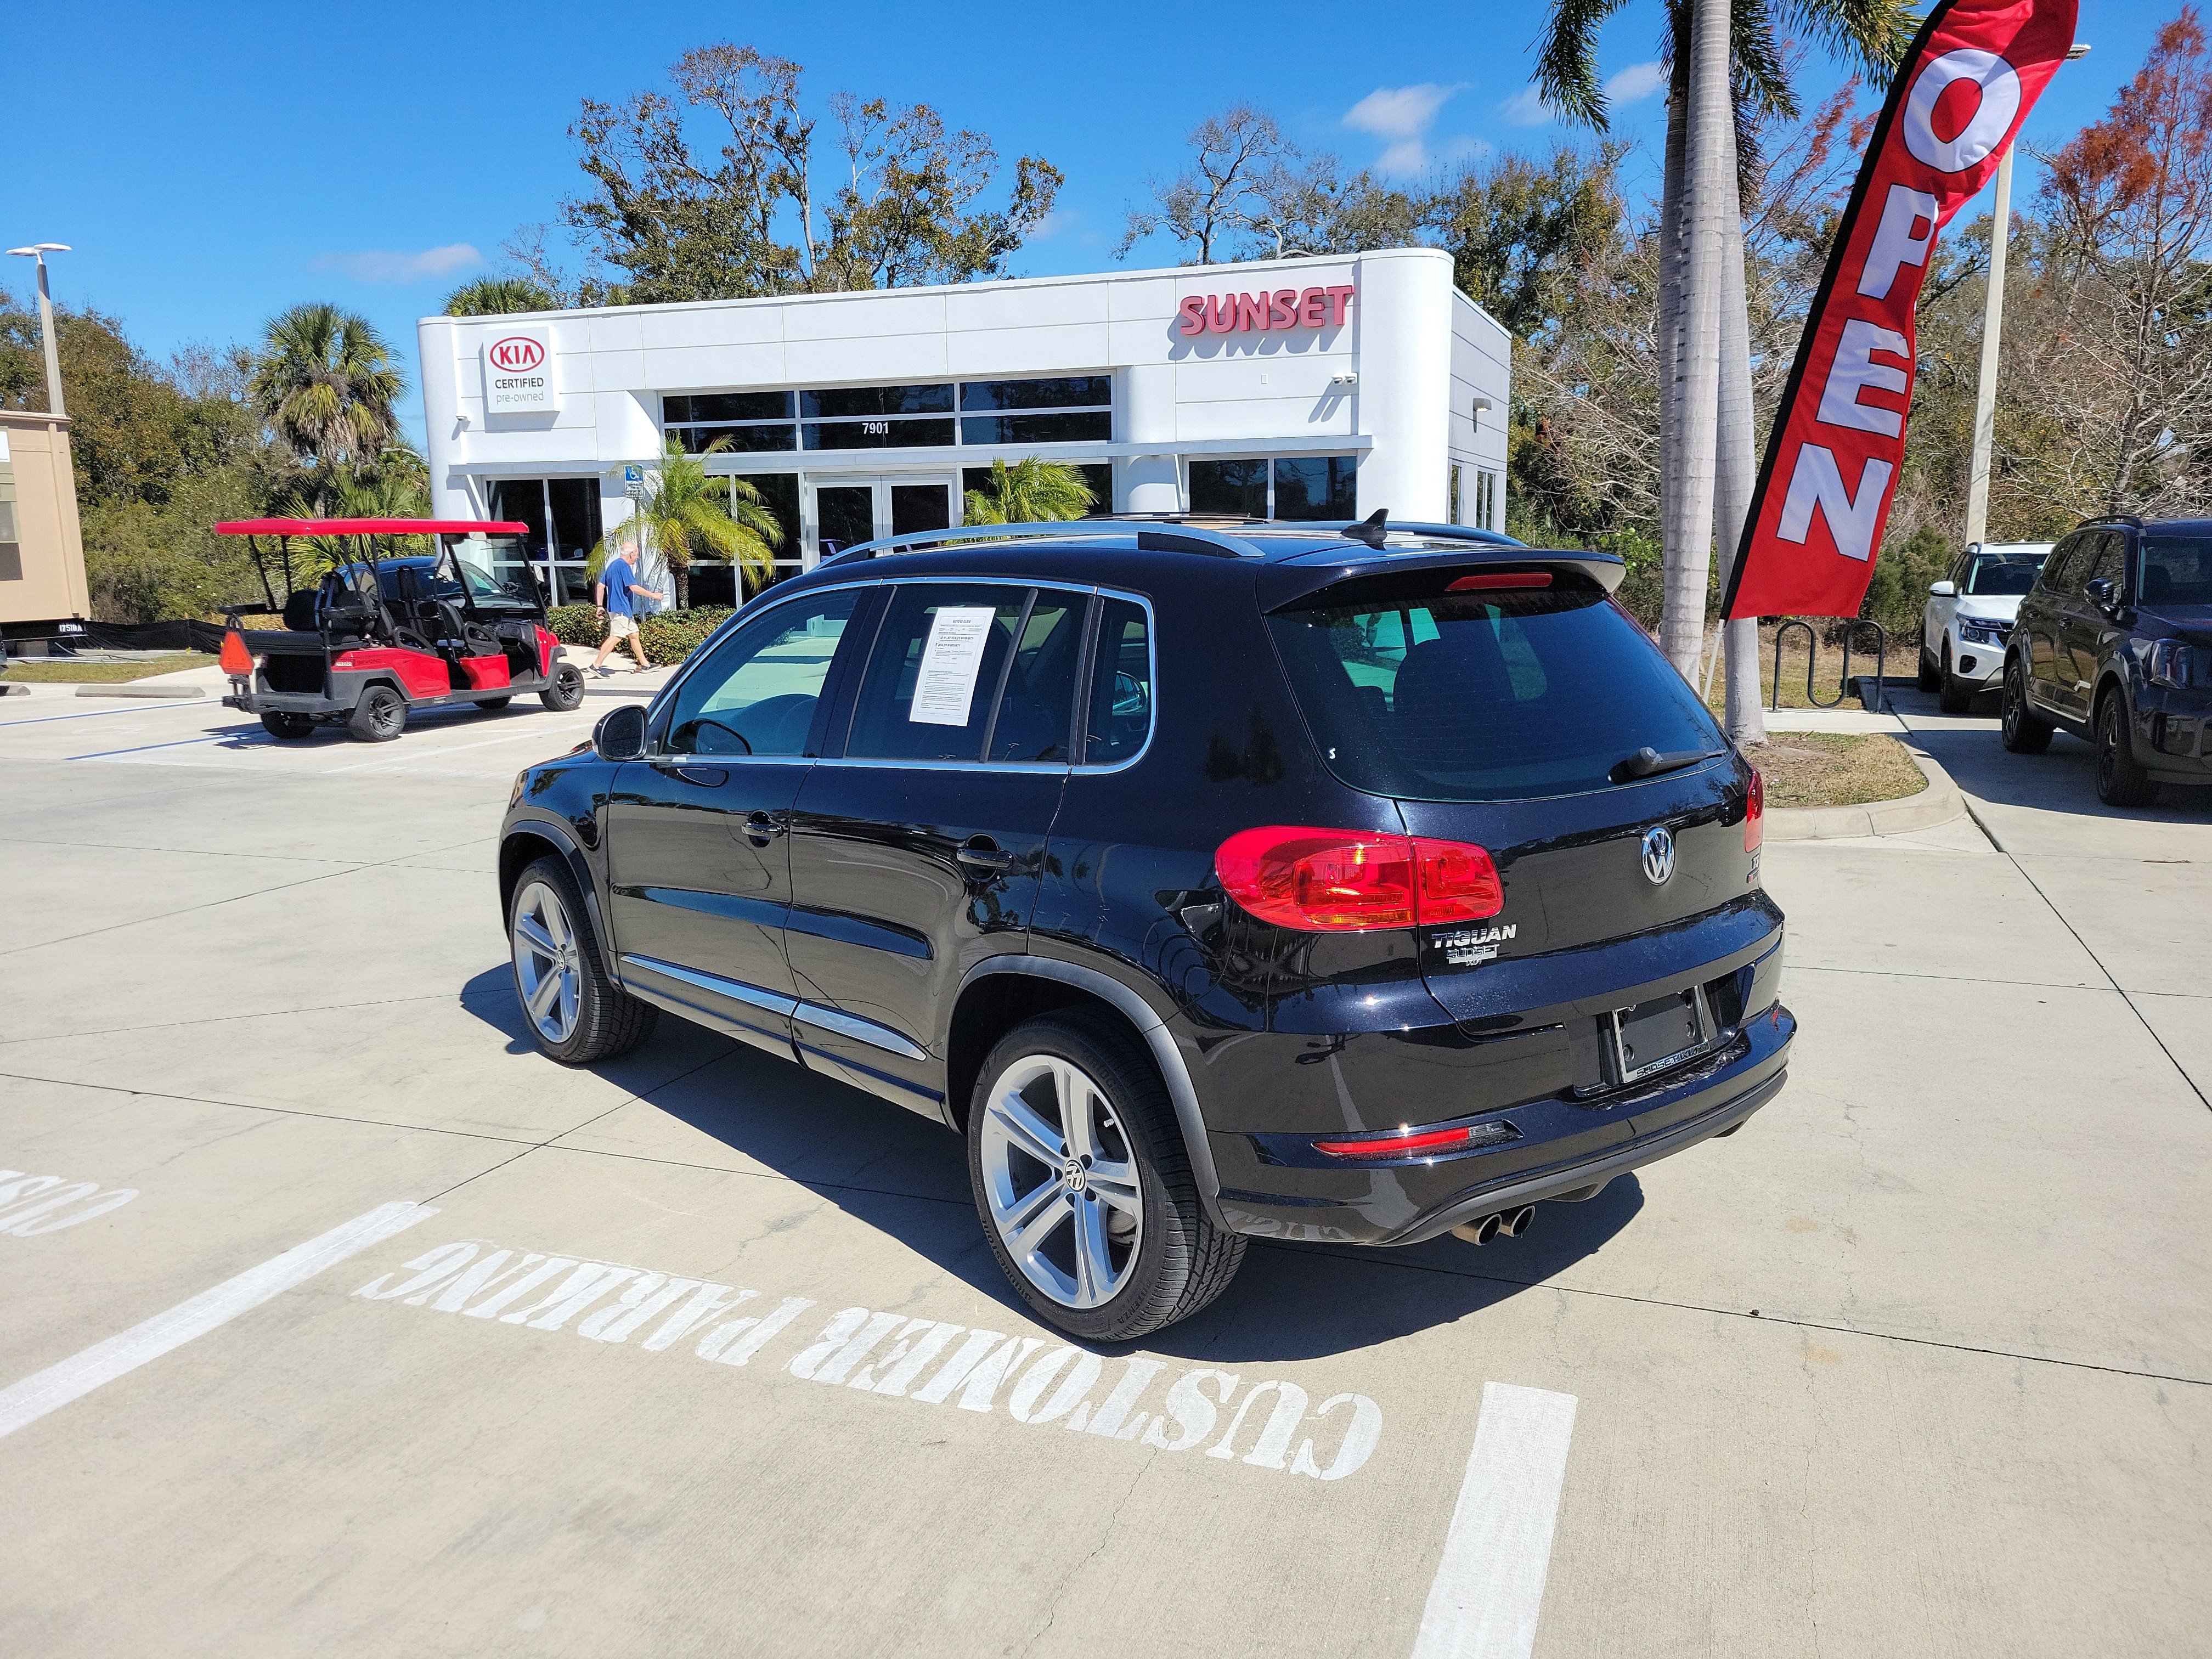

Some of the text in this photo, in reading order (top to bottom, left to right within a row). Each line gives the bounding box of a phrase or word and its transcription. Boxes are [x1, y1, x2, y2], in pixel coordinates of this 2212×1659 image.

[1180, 285, 1355, 336] SUNSET
[1776, 48, 2022, 561] OPEN
[499, 345, 537, 365] KIA
[495, 377, 544, 389] CERTIFIED
[496, 391, 544, 405] pre-owned
[862, 421, 889, 434] 7901
[1431, 924, 1516, 948] TIGUAN
[1446, 944, 1500, 960] SUNSET
[1637, 1056, 1677, 1077] SUNSET
[349, 1239, 1383, 1481] CUSTOMER PARKING
